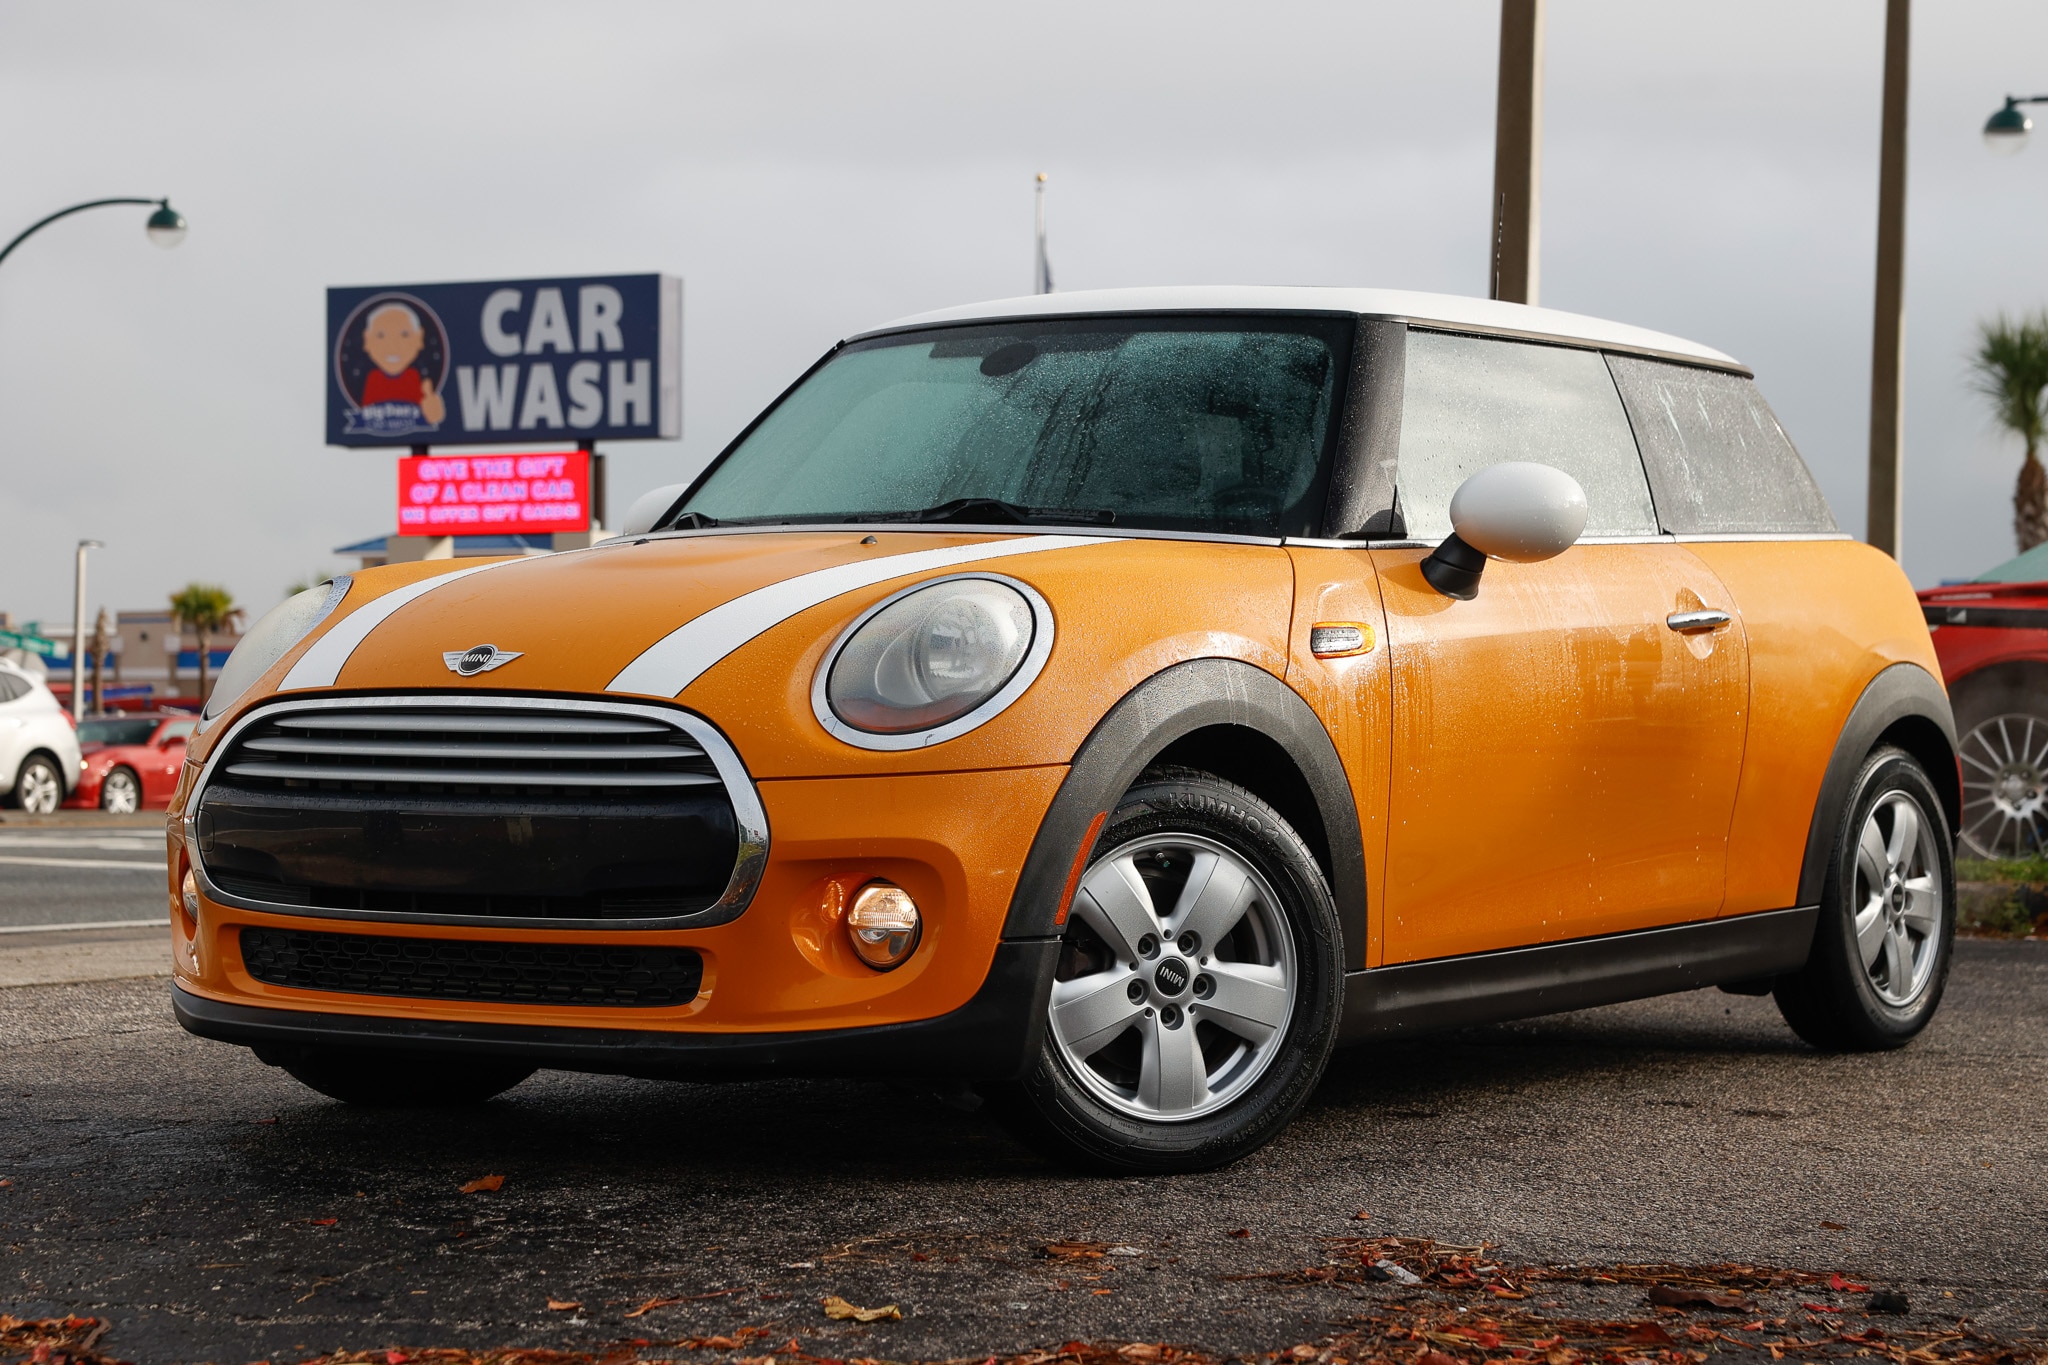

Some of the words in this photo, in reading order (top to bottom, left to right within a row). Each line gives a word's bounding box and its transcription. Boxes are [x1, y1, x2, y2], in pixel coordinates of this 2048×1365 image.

[480, 284, 624, 356] CAR
[456, 359, 651, 431] WASH
[418, 459, 468, 480] GIVE
[471, 458, 514, 479] THE
[517, 456, 566, 478] GIFT
[410, 482, 438, 503] OF
[441, 483, 458, 502] A
[461, 480, 528, 501] CLEAN
[531, 479, 575, 500] CAR
[402, 506, 426, 523] WE
[429, 504, 480, 523] OFFER
[482, 503, 519, 521] GIFT
[462, 653, 491, 663] MINI
[1169, 792, 1263, 835] KUMHO
[1159, 966, 1185, 988] MINI
